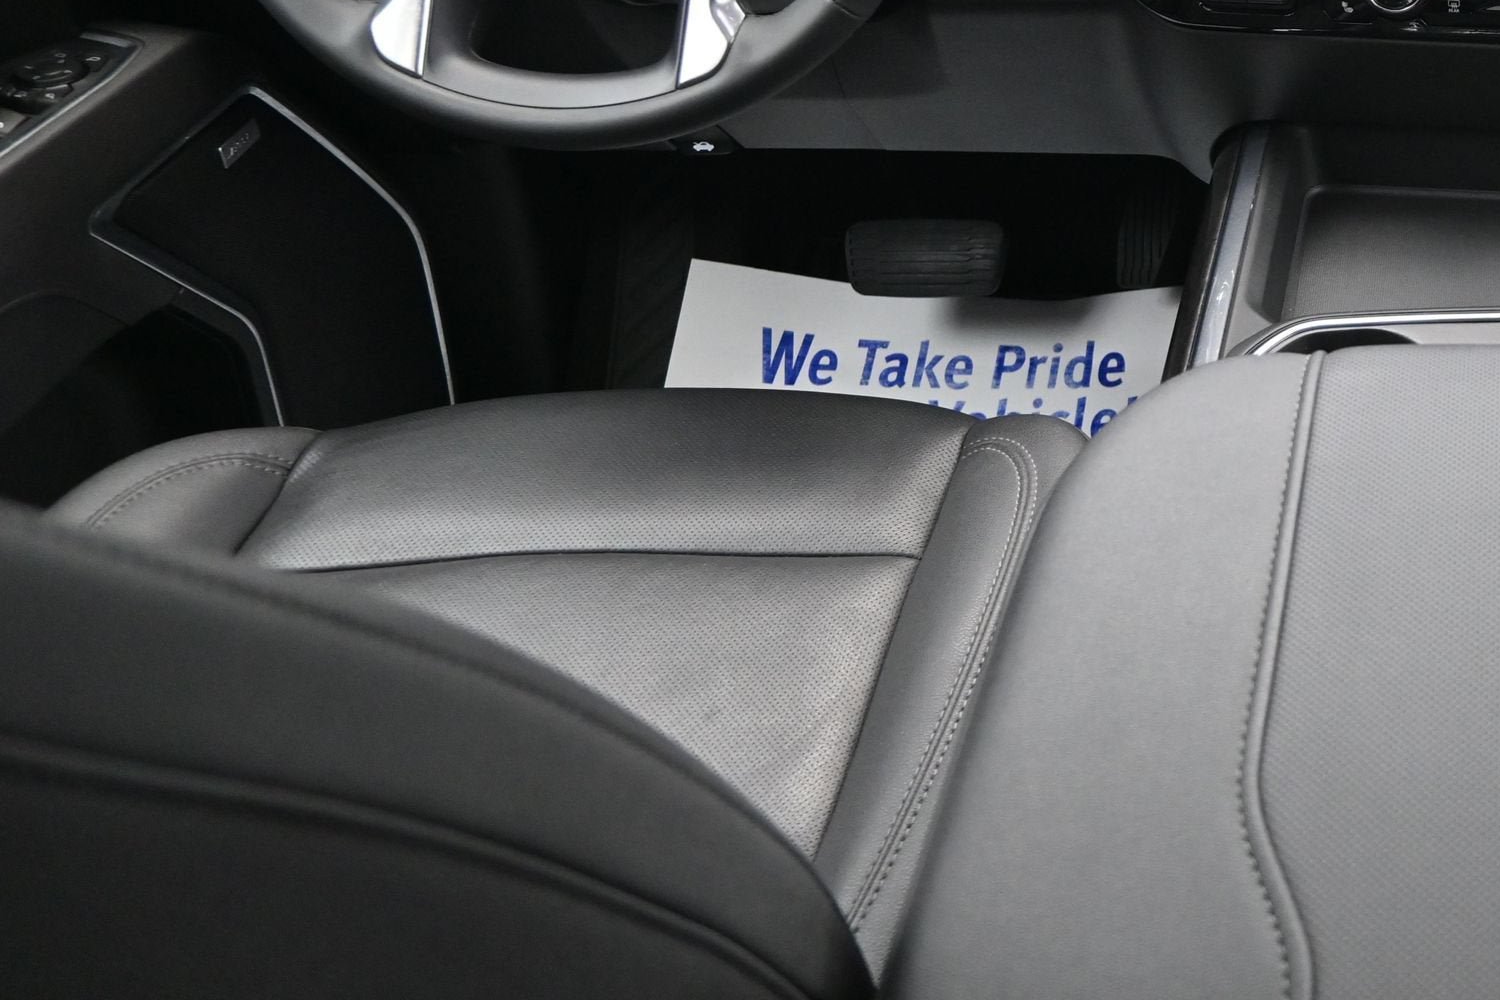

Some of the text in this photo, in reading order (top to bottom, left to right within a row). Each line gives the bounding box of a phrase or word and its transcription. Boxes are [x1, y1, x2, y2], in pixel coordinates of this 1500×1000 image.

[761, 327, 1128, 392] We Take Pride
